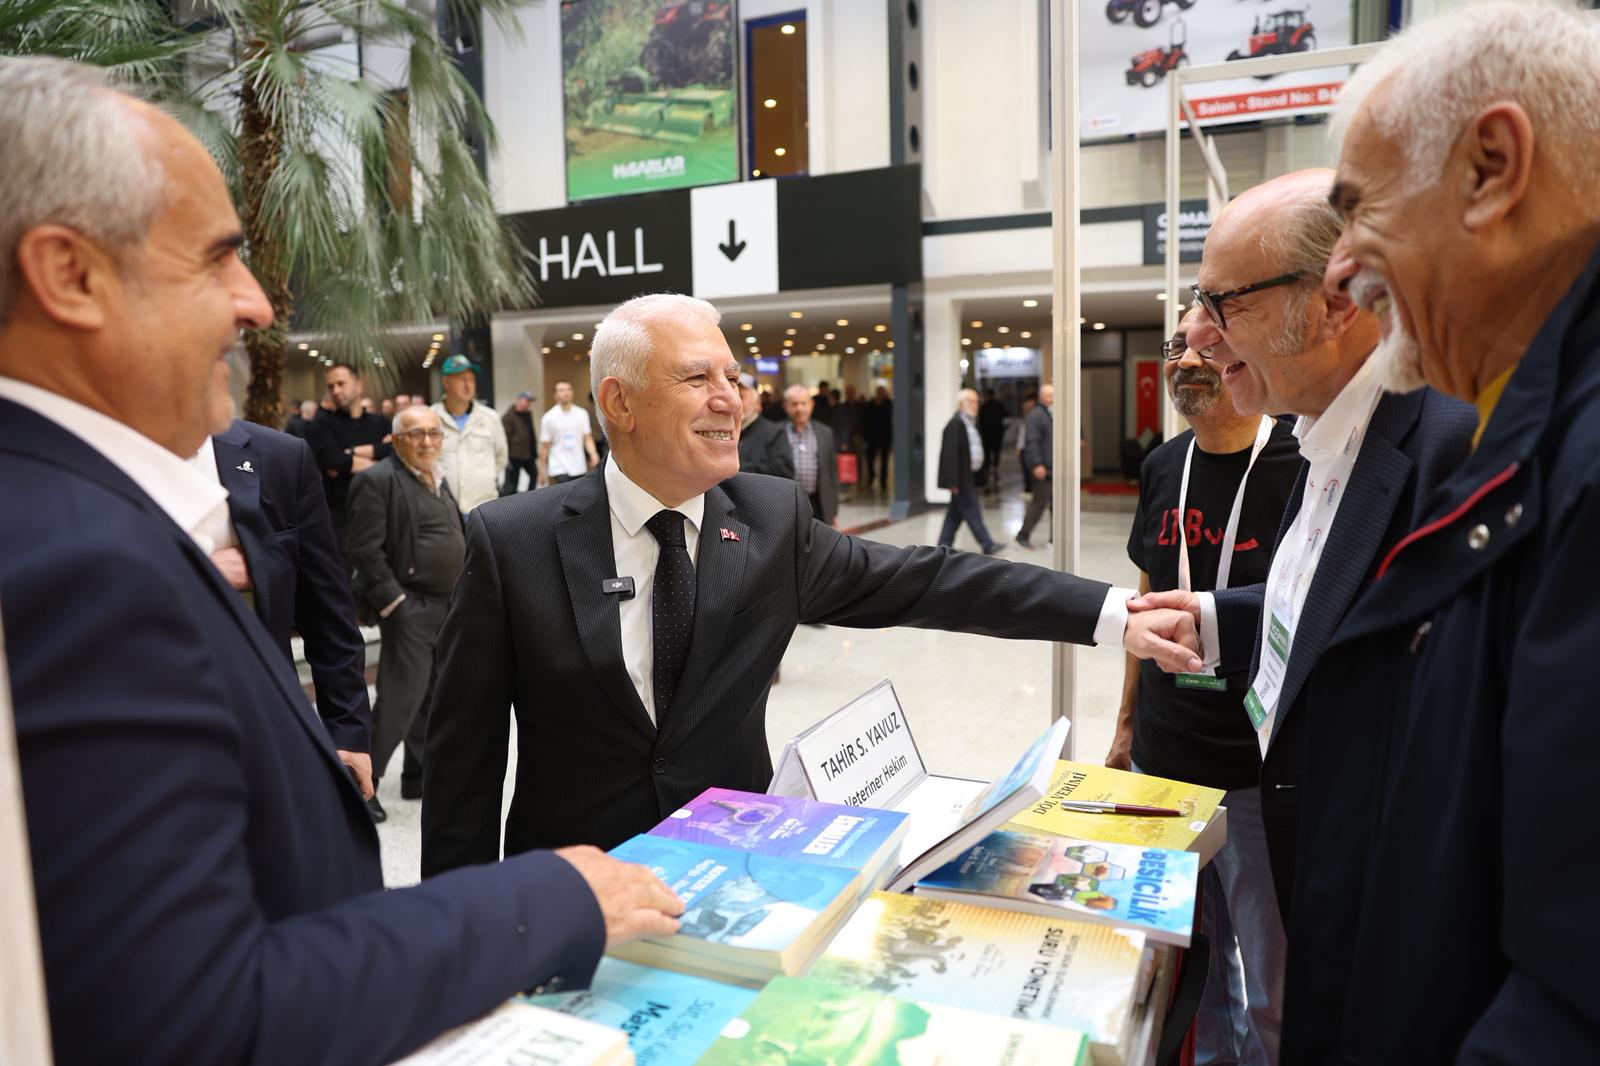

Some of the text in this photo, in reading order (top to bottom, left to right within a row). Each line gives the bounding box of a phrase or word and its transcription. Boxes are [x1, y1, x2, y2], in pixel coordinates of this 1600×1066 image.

[1199, 101, 1237, 116] Salon
[1247, 94, 1289, 110] Stand
[539, 226, 664, 282] HALL
[820, 711, 901, 782] TAHİR S. YAVUZ
[844, 754, 908, 808] Veteriner Hekim
[1051, 770, 1088, 803] VERİMİ
[1128, 851, 1172, 925] BESİCİLİK
